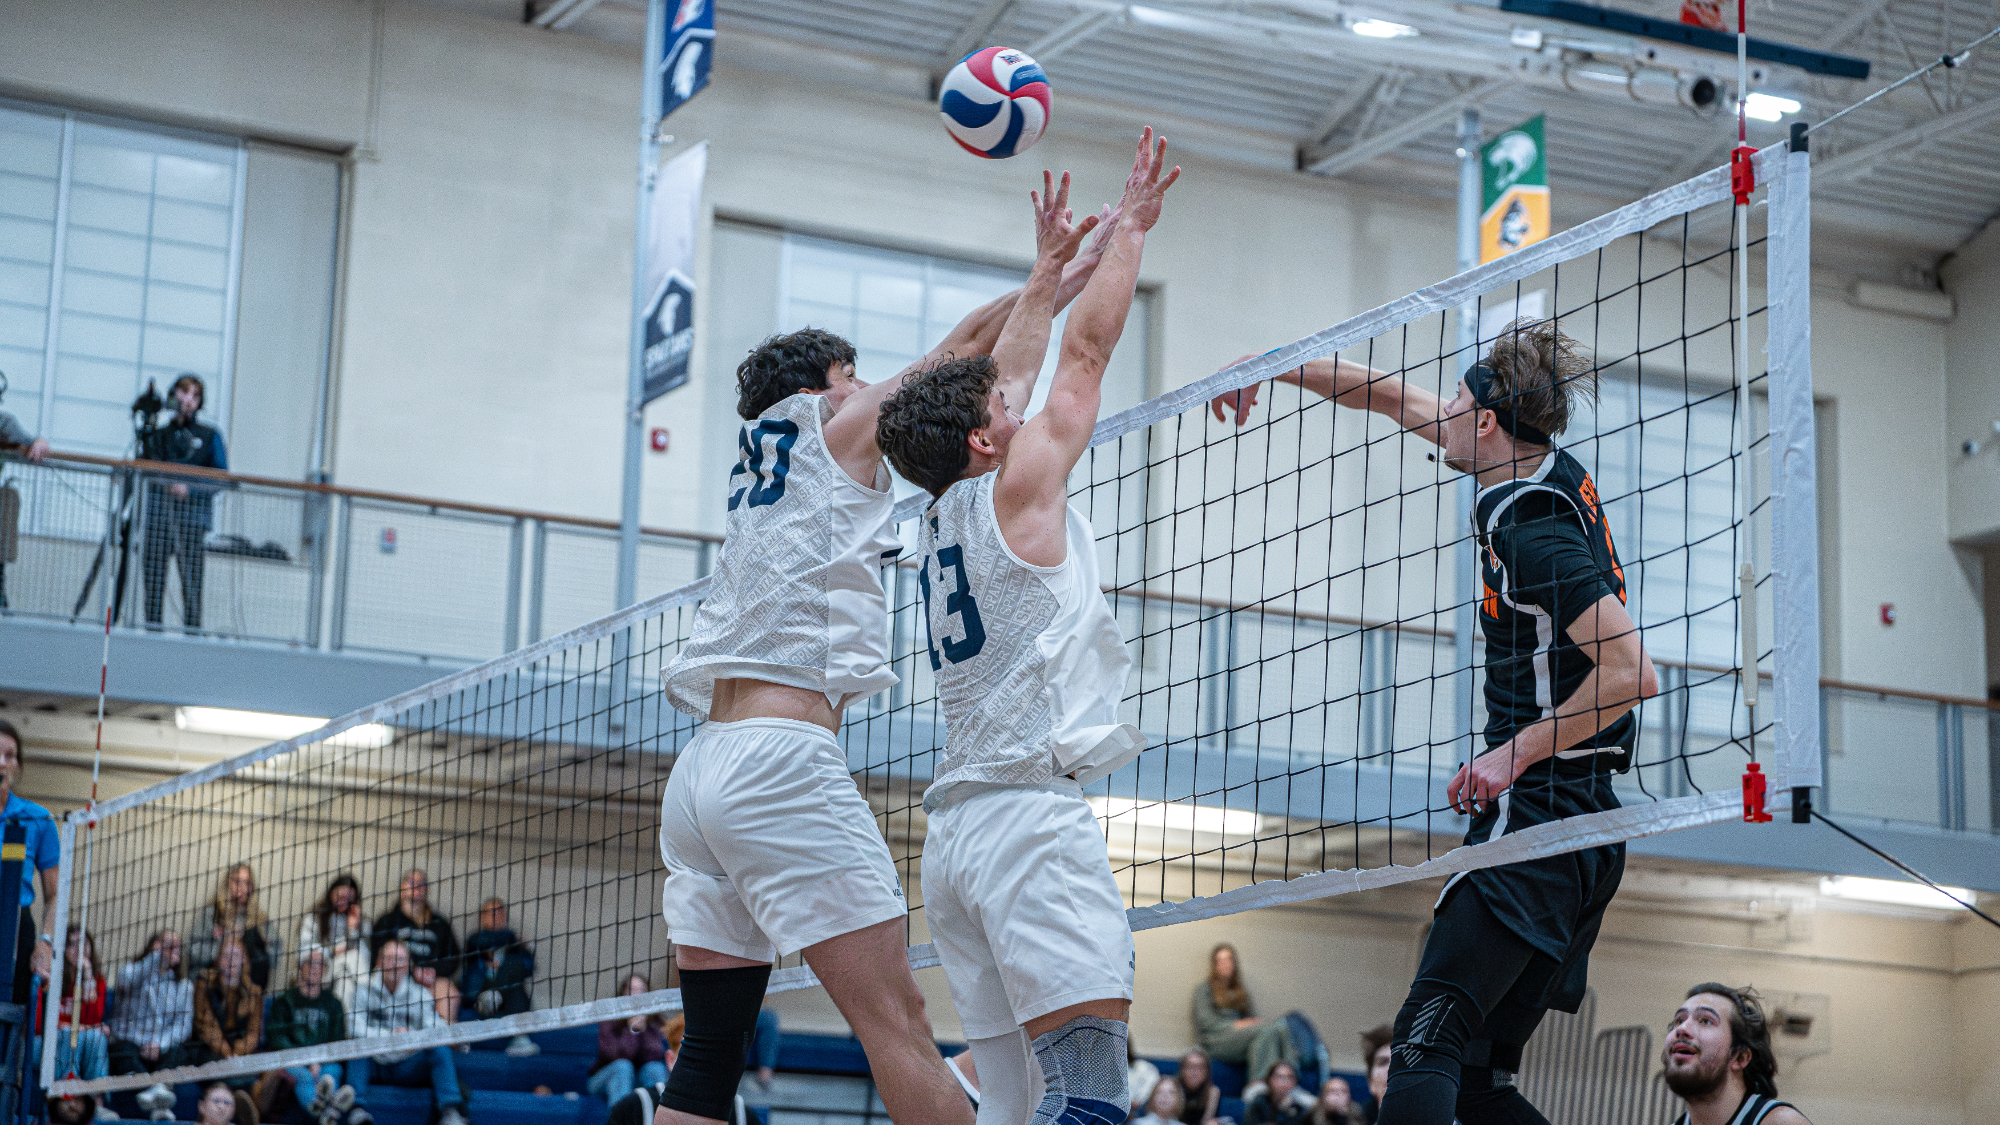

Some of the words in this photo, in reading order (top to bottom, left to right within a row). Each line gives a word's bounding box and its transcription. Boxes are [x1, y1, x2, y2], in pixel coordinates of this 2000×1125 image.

[728, 418, 799, 511] 20
[919, 543, 986, 671] 13
[1000, 681, 1041, 727] SPARTAN
